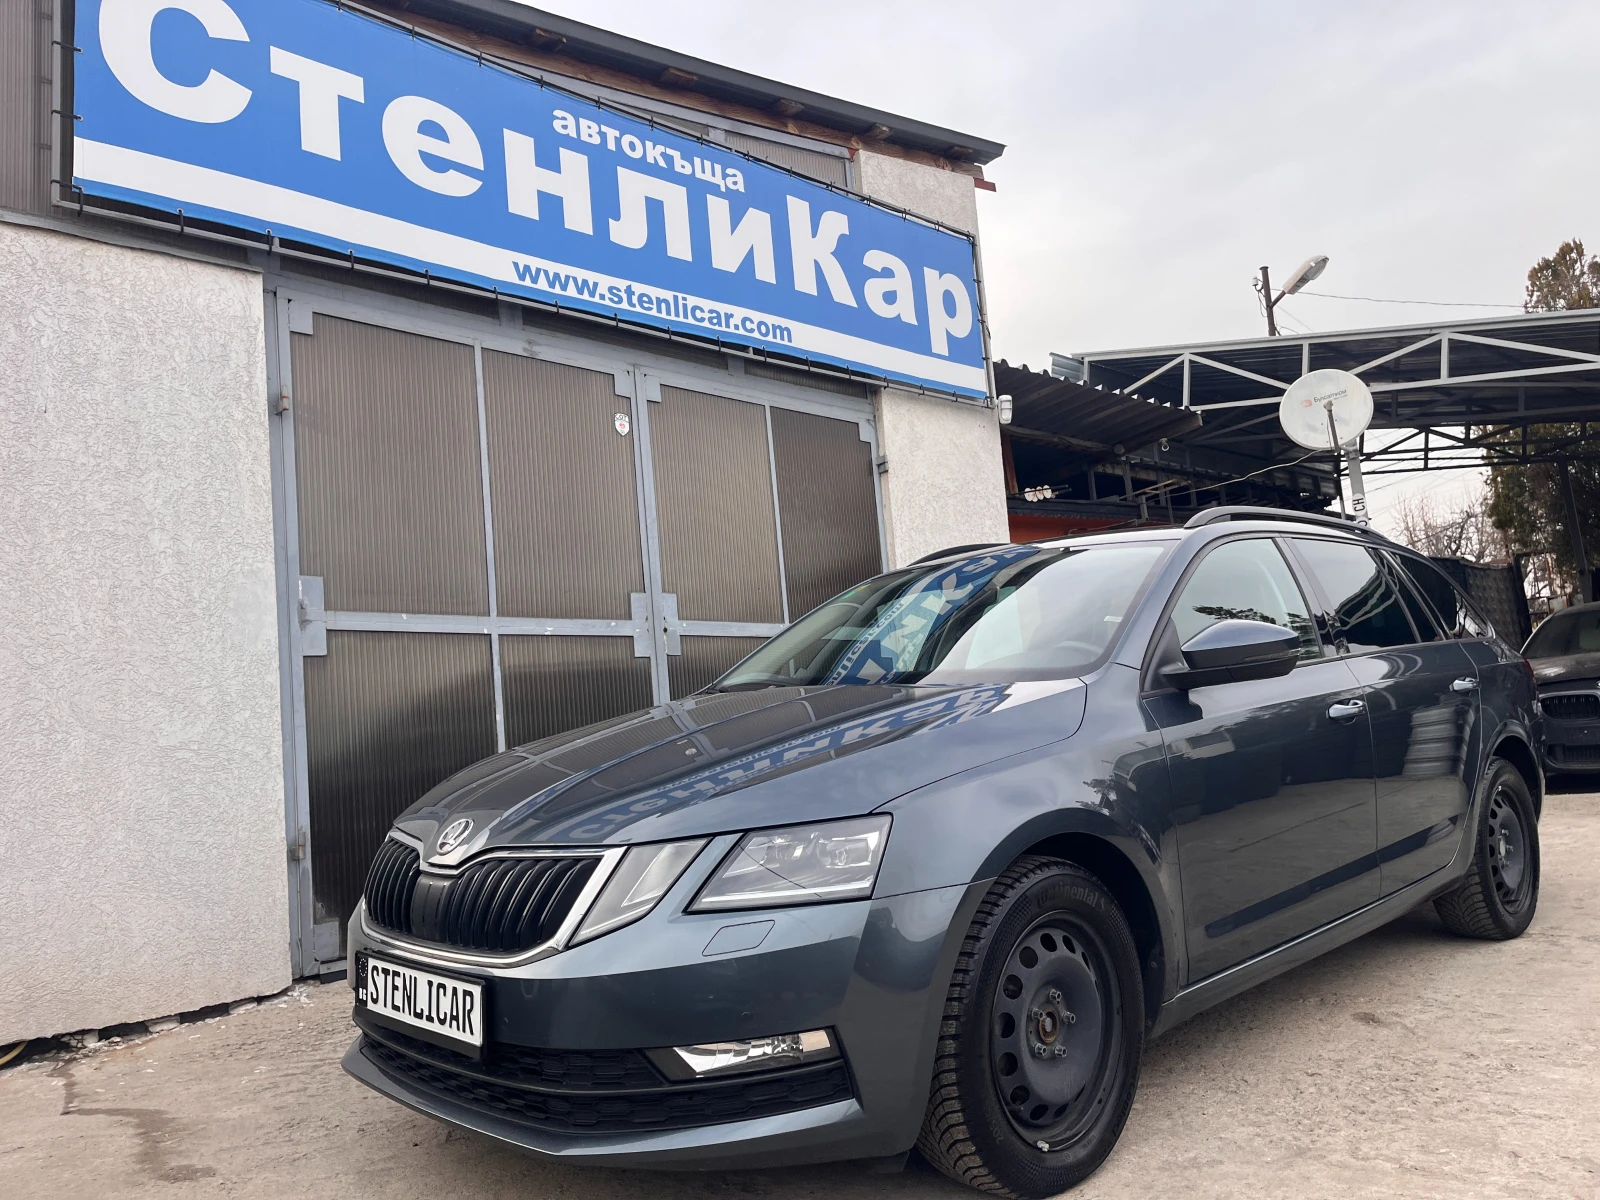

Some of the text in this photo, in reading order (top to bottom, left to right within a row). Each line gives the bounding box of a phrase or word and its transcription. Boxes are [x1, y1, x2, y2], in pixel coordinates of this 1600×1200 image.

[98, 0, 973, 357] СтенлиКар
[552, 108, 745, 193] автокъща
[512, 260, 793, 344] www.stenlicar.com
[359, 987, 367, 1001] BG
[370, 964, 475, 1036] STENLICAR
